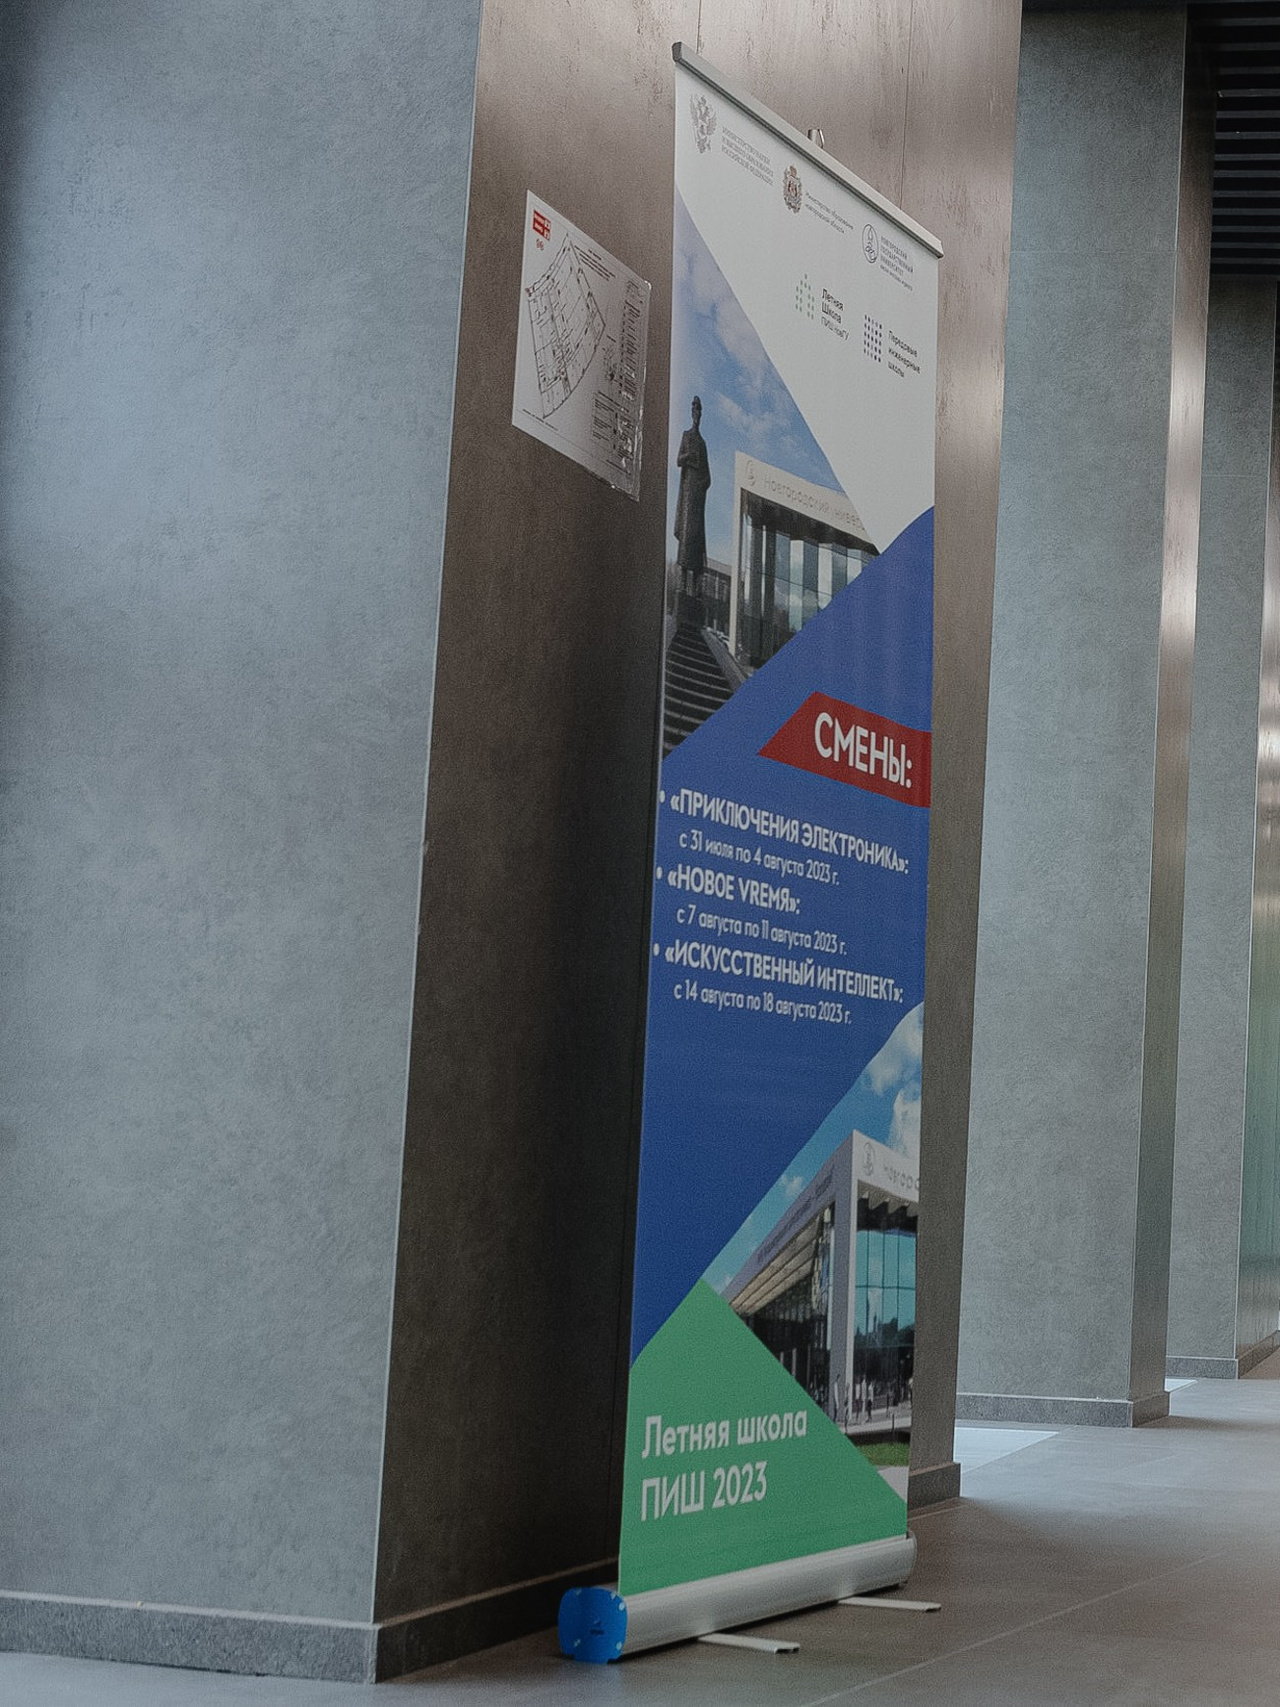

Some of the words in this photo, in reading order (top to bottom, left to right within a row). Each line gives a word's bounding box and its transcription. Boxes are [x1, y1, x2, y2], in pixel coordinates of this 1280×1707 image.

[814, 712, 913, 789] СМЕНЫ:
[670, 788, 800, 844] «ПРИКЛЮЧЕНИЯ
[801, 822, 910, 875] ЭЛЕКТРОНИКА»:
[679, 832, 688, 849] с
[690, 829, 703, 852] 31
[705, 838, 734, 860] июля
[736, 847, 752, 864] по
[753, 846, 763, 866] 4
[763, 854, 804, 879] августа
[806, 859, 831, 884] 2023
[832, 871, 840, 886] г.
[667, 863, 735, 901] «НОВОЕ
[676, 908, 686, 924] с
[688, 904, 697, 925] 7
[698, 912, 742, 937] августа
[744, 921, 760, 939] по
[761, 919, 770, 940] 11
[770, 927, 812, 951] августа
[813, 930, 838, 954] 2023
[839, 941, 847, 956] г.
[665, 939, 816, 989] «ИСКУССТВЕННЫЙ
[816, 965, 904, 1004] ИНТЕЛЛЕКТ»:
[673, 983, 683, 1000] с
[685, 979, 699, 1001] 14
[700, 987, 744, 1012] августа
[746, 994, 761, 1012] по
[762, 991, 775, 1013] 18
[775, 999, 817, 1022] августа
[818, 1000, 843, 1024] 2023
[844, 1010, 852, 1025] г.
[641, 1414, 731, 1460] Летняя
[737, 1409, 808, 1446] школа
[640, 1469, 706, 1522] ПИШ
[712, 1460, 768, 1510] 2023
